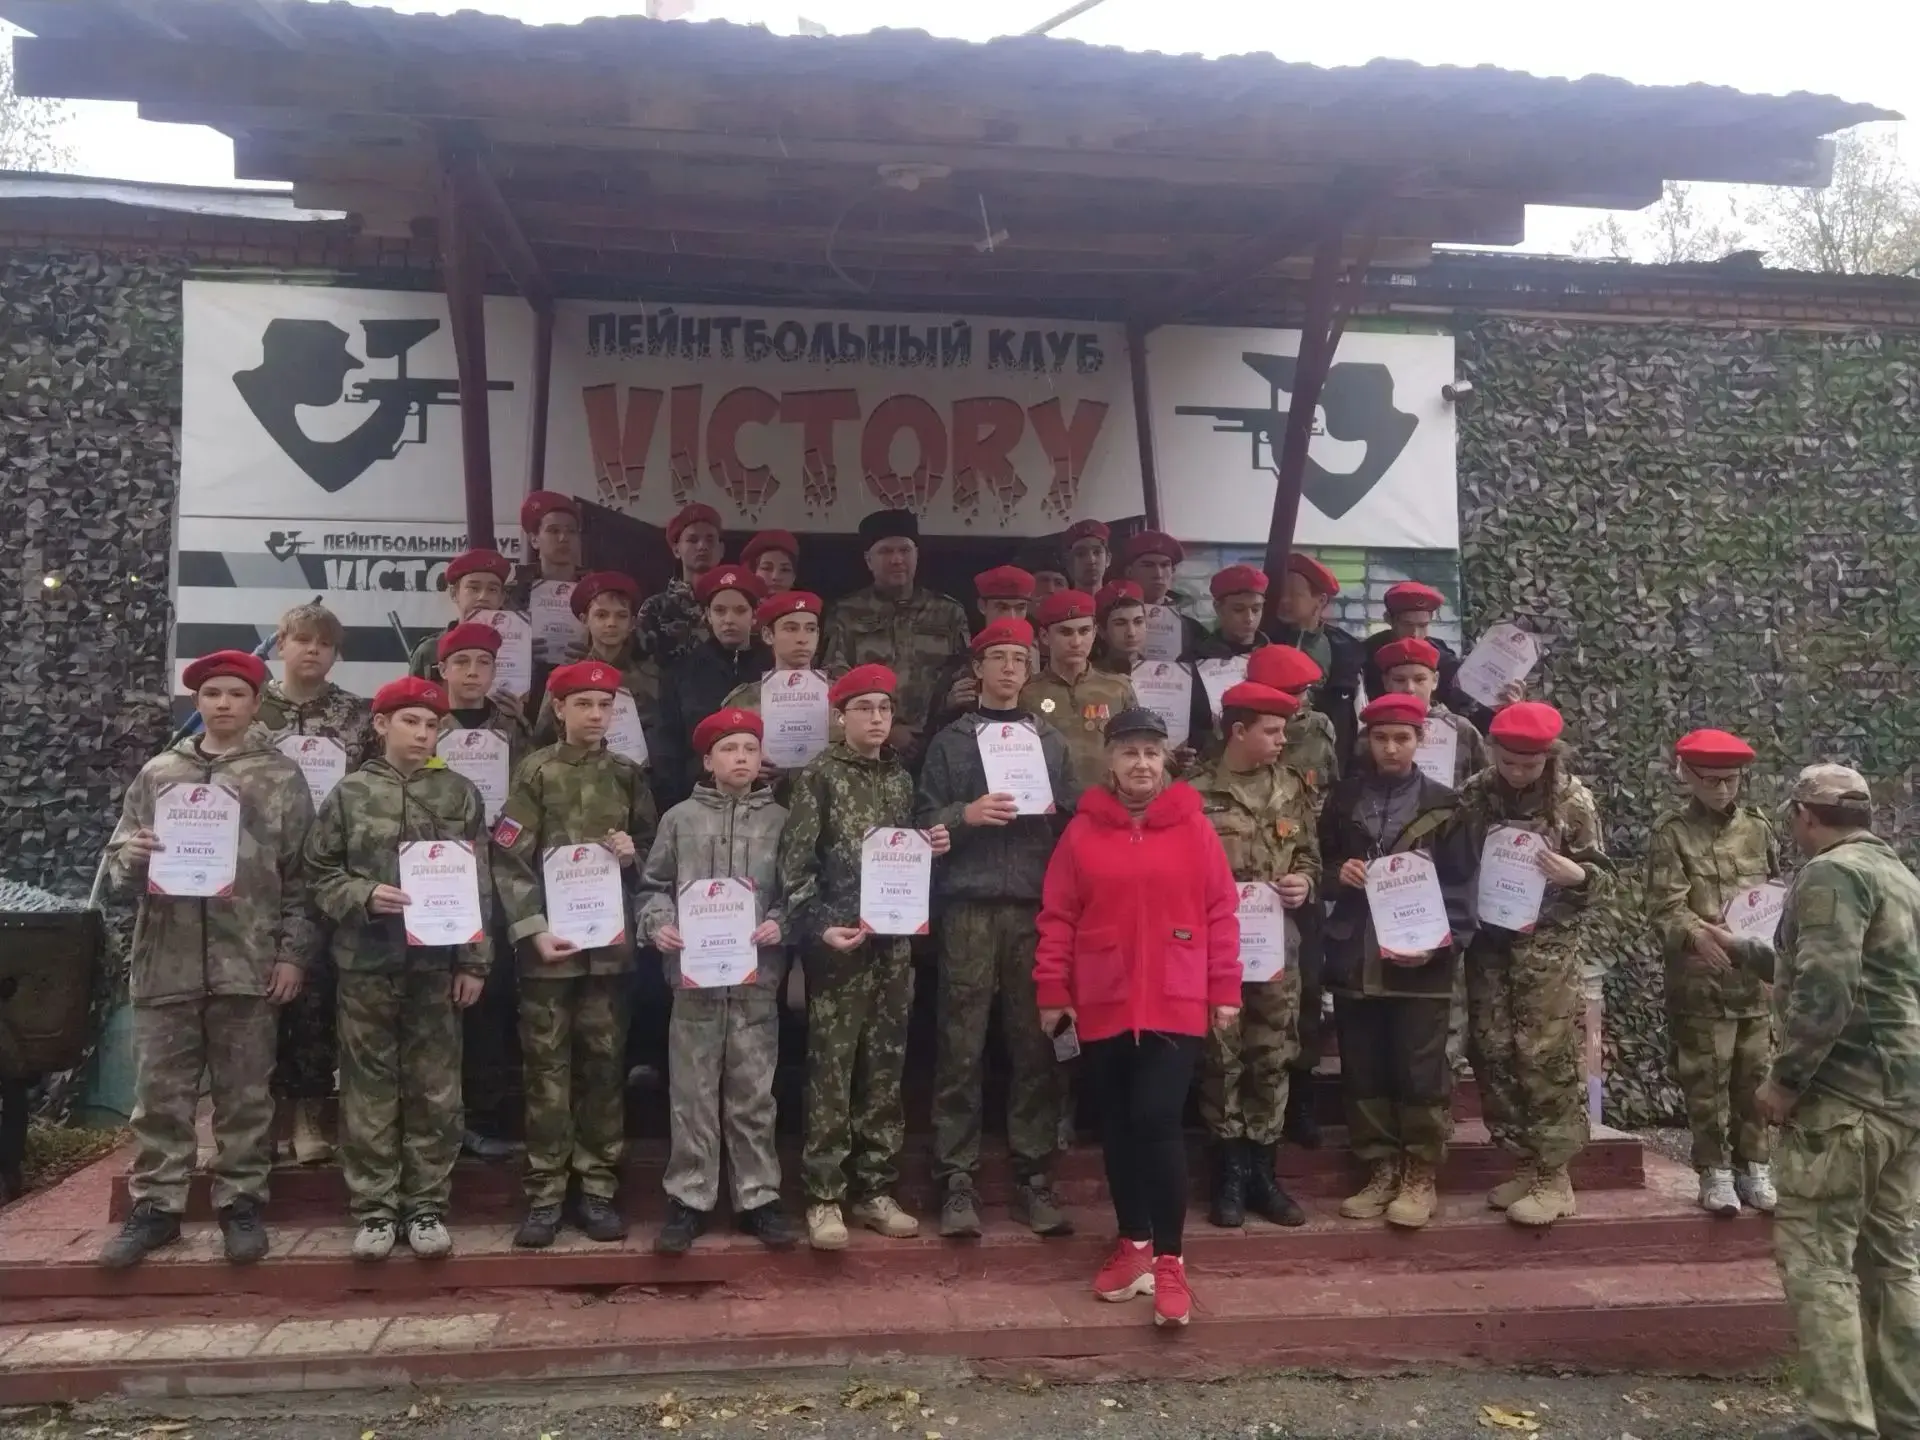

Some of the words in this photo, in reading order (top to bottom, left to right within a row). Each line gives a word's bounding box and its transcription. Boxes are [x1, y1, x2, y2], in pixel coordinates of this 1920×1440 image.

[587, 306, 973, 367] ПЕЙНТБОЛЬНЫЙ
[987, 329, 1105, 372] КЛУБ
[582, 383, 1110, 520] VICTORY
[323, 532, 468, 553] ПЕЙНТБОЛЬНЫЙ
[324, 558, 516, 593] VICTO
[771, 692, 820, 703] ДИПЛОМ
[780, 724, 786, 732] 2
[787, 724, 812, 732] МЕСТО
[167, 808, 228, 820] ДИПЛОМ
[176, 845, 181, 854] 1
[183, 846, 215, 855] МЕСТО
[1492, 847, 1534, 864] ДИПЛО
[871, 852, 923, 863] ДИПЛОМ
[411, 864, 467, 876] ДИПЛОМ
[555, 864, 610, 882] ДИПЛОМ
[1376, 871, 1428, 893] ДИПЛОМ
[423, 899, 430, 907] 2
[688, 901, 744, 917] ДИПЛОМ
[1393, 911, 1398, 919] 1
[1399, 907, 1426, 917] МЕСТО
[701, 939, 708, 948] 2
